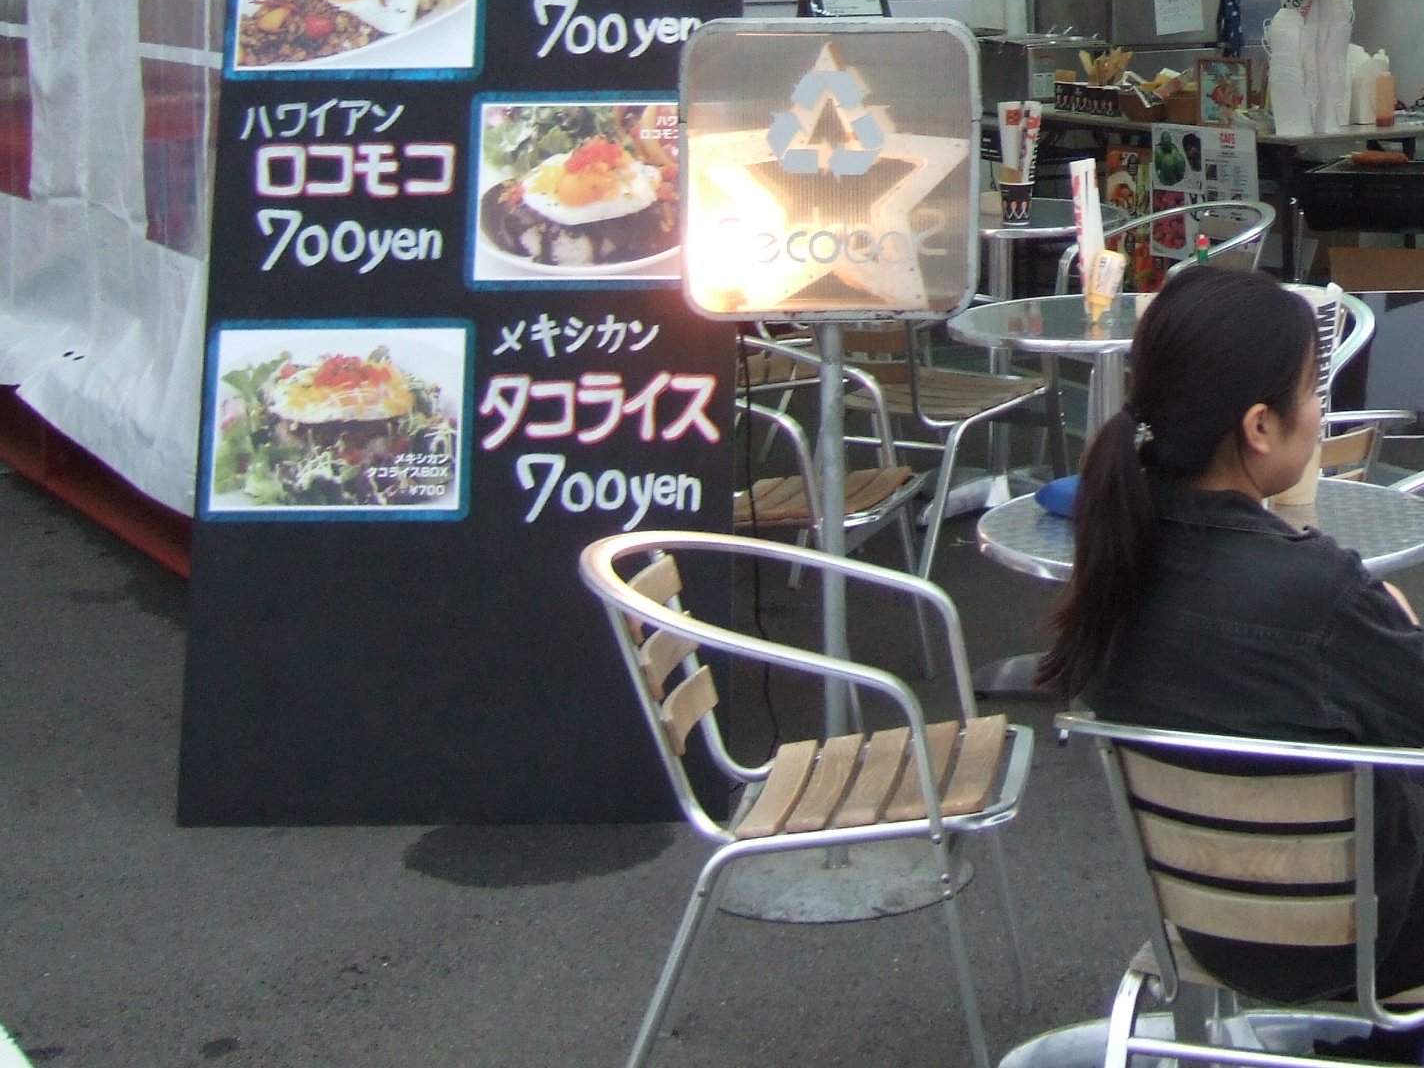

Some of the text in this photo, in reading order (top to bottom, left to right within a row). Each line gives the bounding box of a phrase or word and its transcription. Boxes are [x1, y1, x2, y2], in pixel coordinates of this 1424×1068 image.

[240, 98, 405, 140] ハワイアン
[256, 142, 456, 197] ロコモコ
[493, 313, 659, 357] メキシカン
[480, 373, 720, 450] タコライス
